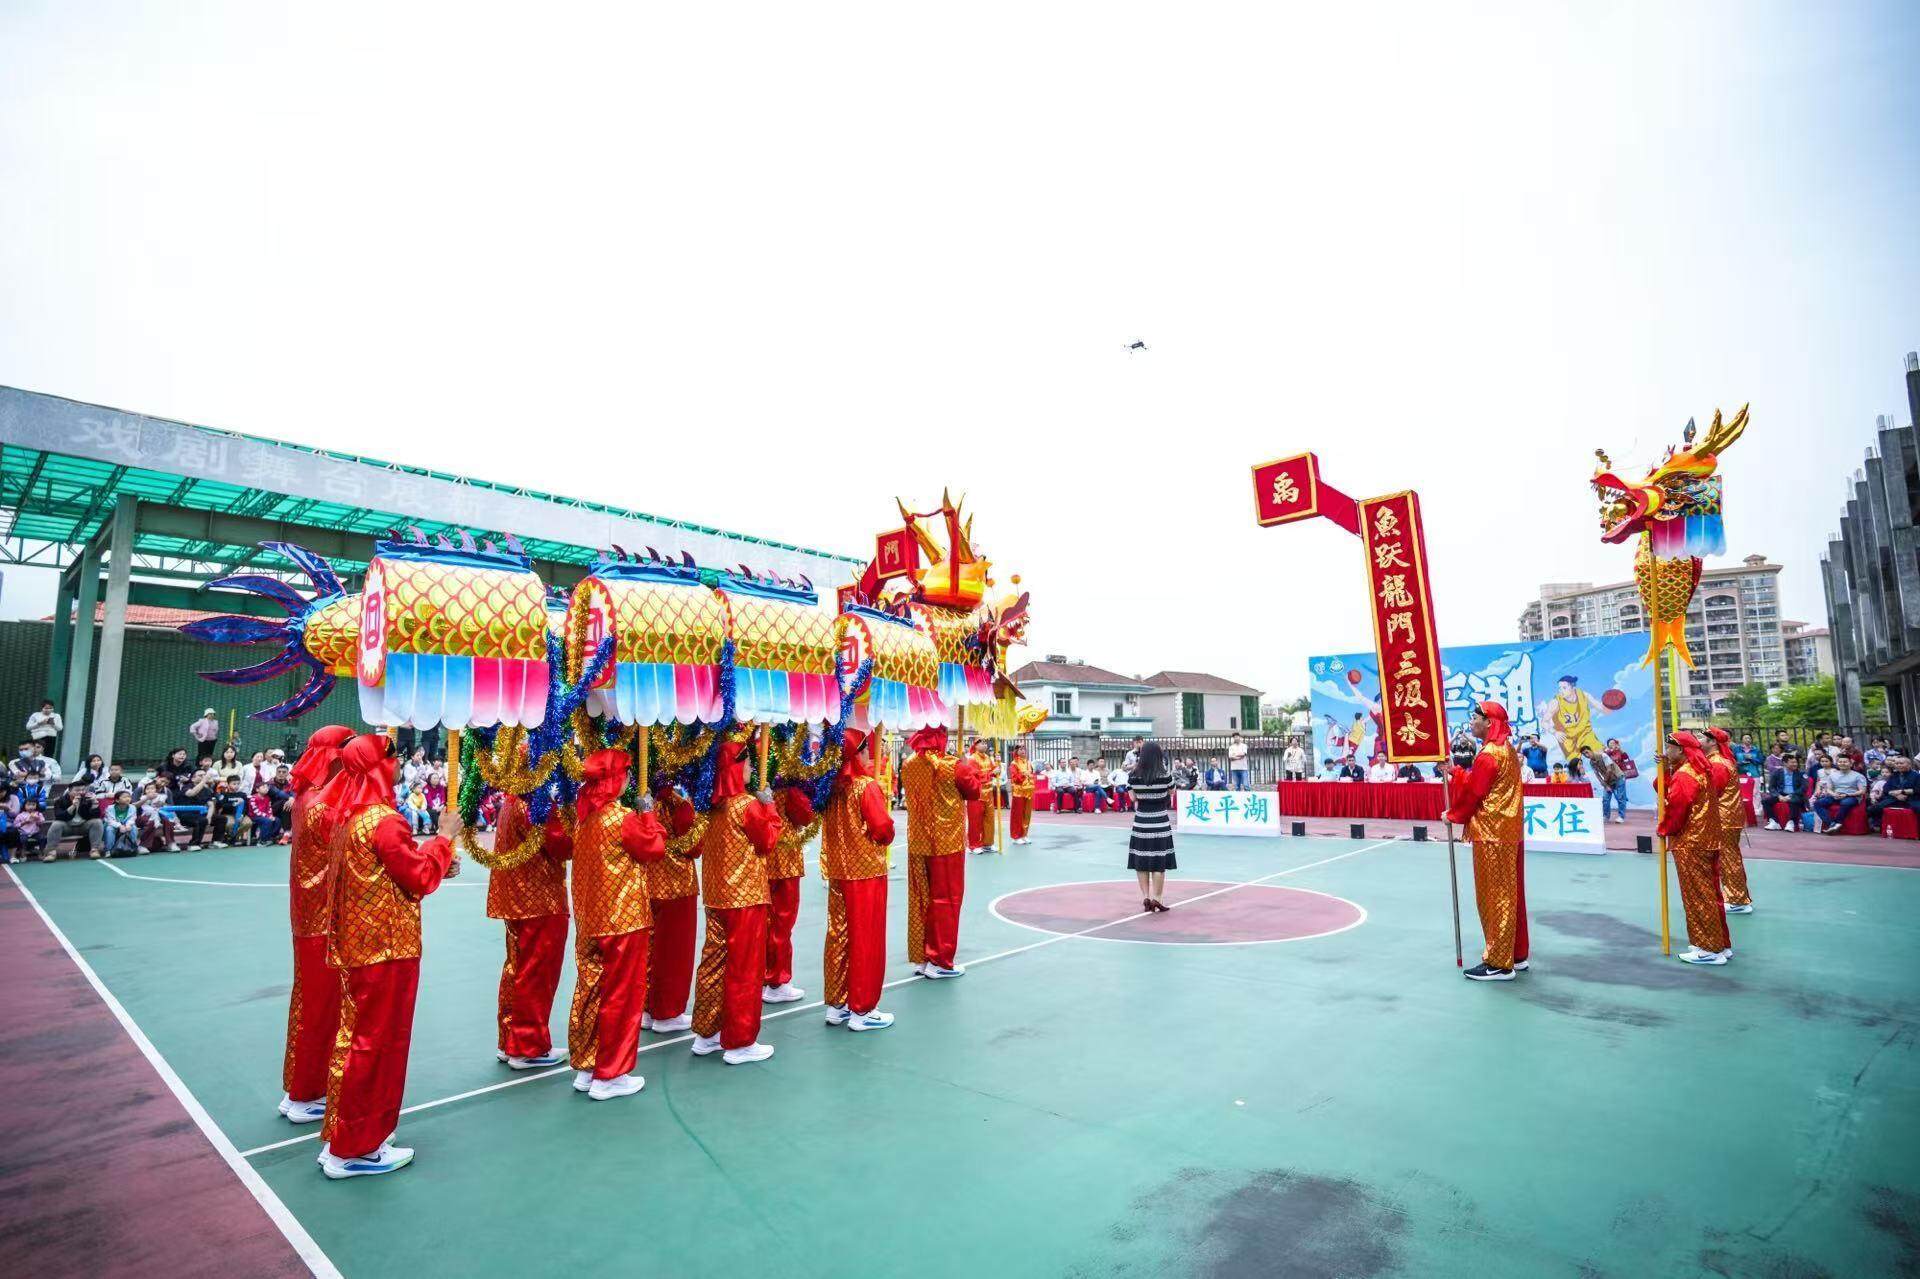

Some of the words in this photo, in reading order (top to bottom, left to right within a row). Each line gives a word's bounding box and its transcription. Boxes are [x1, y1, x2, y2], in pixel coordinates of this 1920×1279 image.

[1273, 472, 1299, 504] 禹
[885, 540, 900, 564] 門
[1564, 713, 1578, 724] 21
[1186, 793, 1268, 824] 趣平湖
[1524, 802, 1590, 836] 不住
